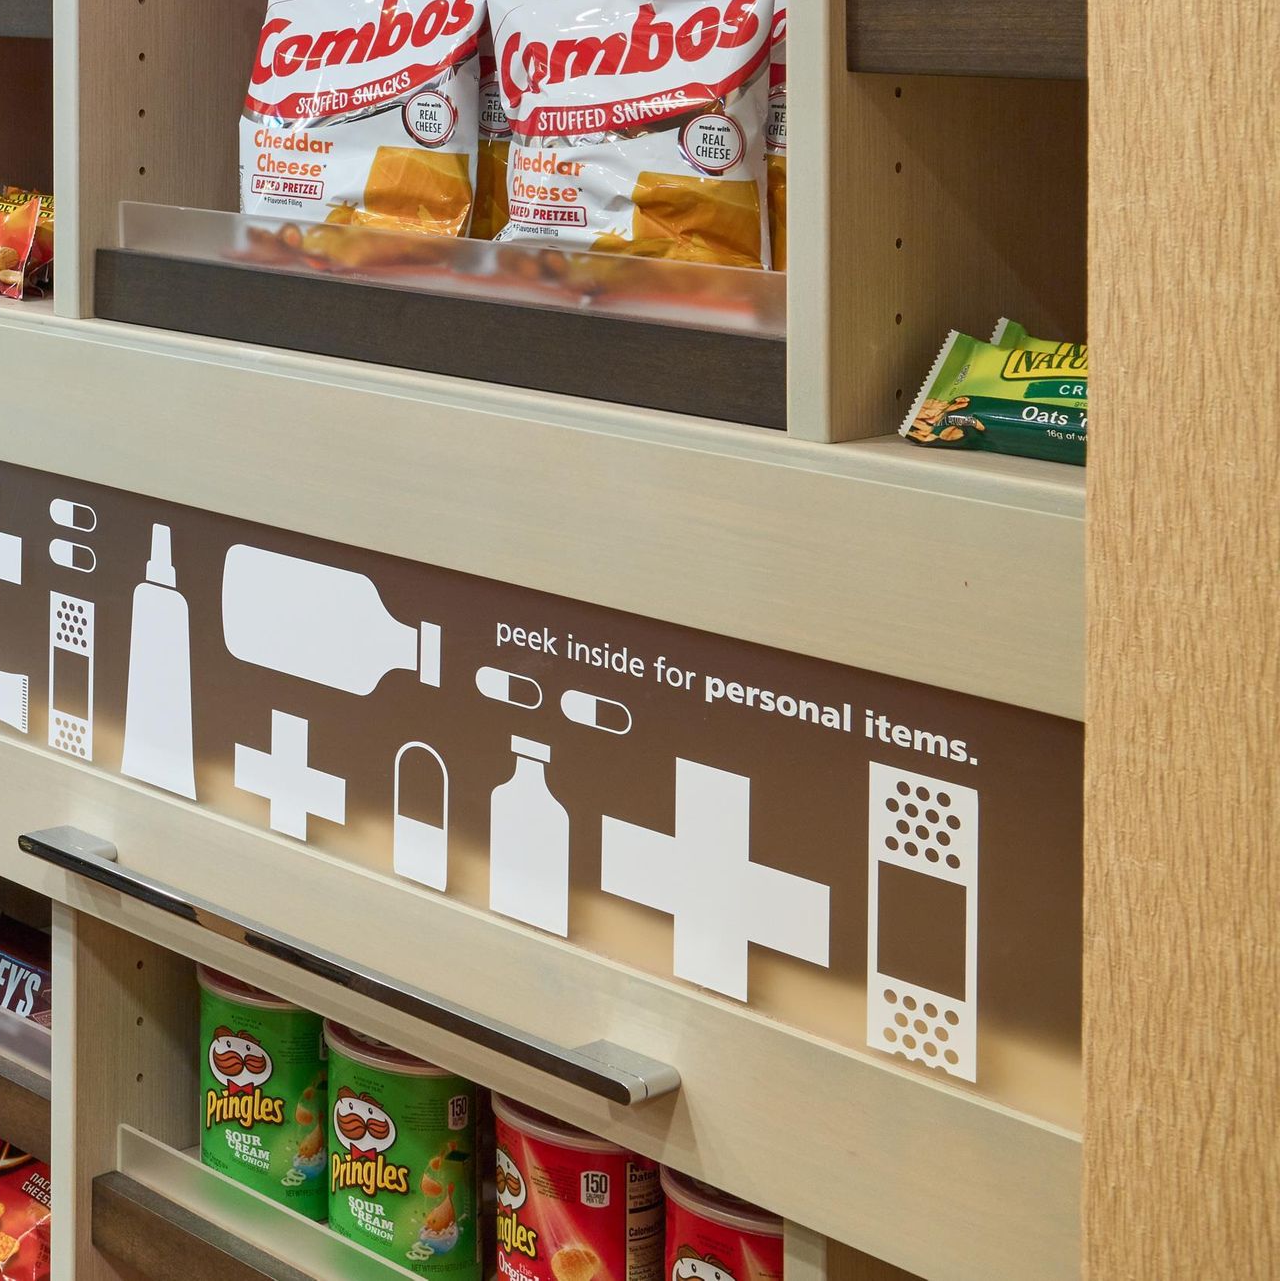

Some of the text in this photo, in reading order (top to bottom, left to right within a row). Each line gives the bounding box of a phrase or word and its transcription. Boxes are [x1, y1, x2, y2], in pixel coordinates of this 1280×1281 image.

[296, 70, 411, 115] STUFFED SNACKS
[487, 99, 503, 111] REA
[537, 90, 688, 132] STUFFED SNACKS
[419, 110, 438, 122] REAL
[481, 111, 507, 124] CHEES
[415, 121, 442, 134] CHEESE
[699, 124, 731, 133] made with
[254, 129, 333, 155] Cheddar
[702, 133, 726, 147] REAL
[513, 149, 584, 177] Cheddar
[695, 147, 731, 161] CHEESE
[255, 179, 318, 196] BAKED PRETZEL
[532, 208, 580, 222] PRETZEL
[1013, 351, 1087, 374] NATU
[1022, 406, 1069, 425] Oats
[1047, 429, 1075, 440] 16g of
[496, 622, 978, 766] peek inside for personal items.
[207, 1089, 285, 1129] Pringles
[450, 1097, 468, 1117] 150
[225, 1129, 262, 1147] SOUR
[227, 1139, 271, 1160] CREAM
[241, 1154, 270, 1170] ONION
[332, 1153, 409, 1195] Pringles
[583, 1173, 608, 1194] 150
[348, 1195, 385, 1216] SOUR
[350, 1206, 394, 1232] CREAM
[364, 1223, 394, 1241] ONION
[497, 1210, 537, 1258] ingles
[518, 1262, 533, 1278] the
